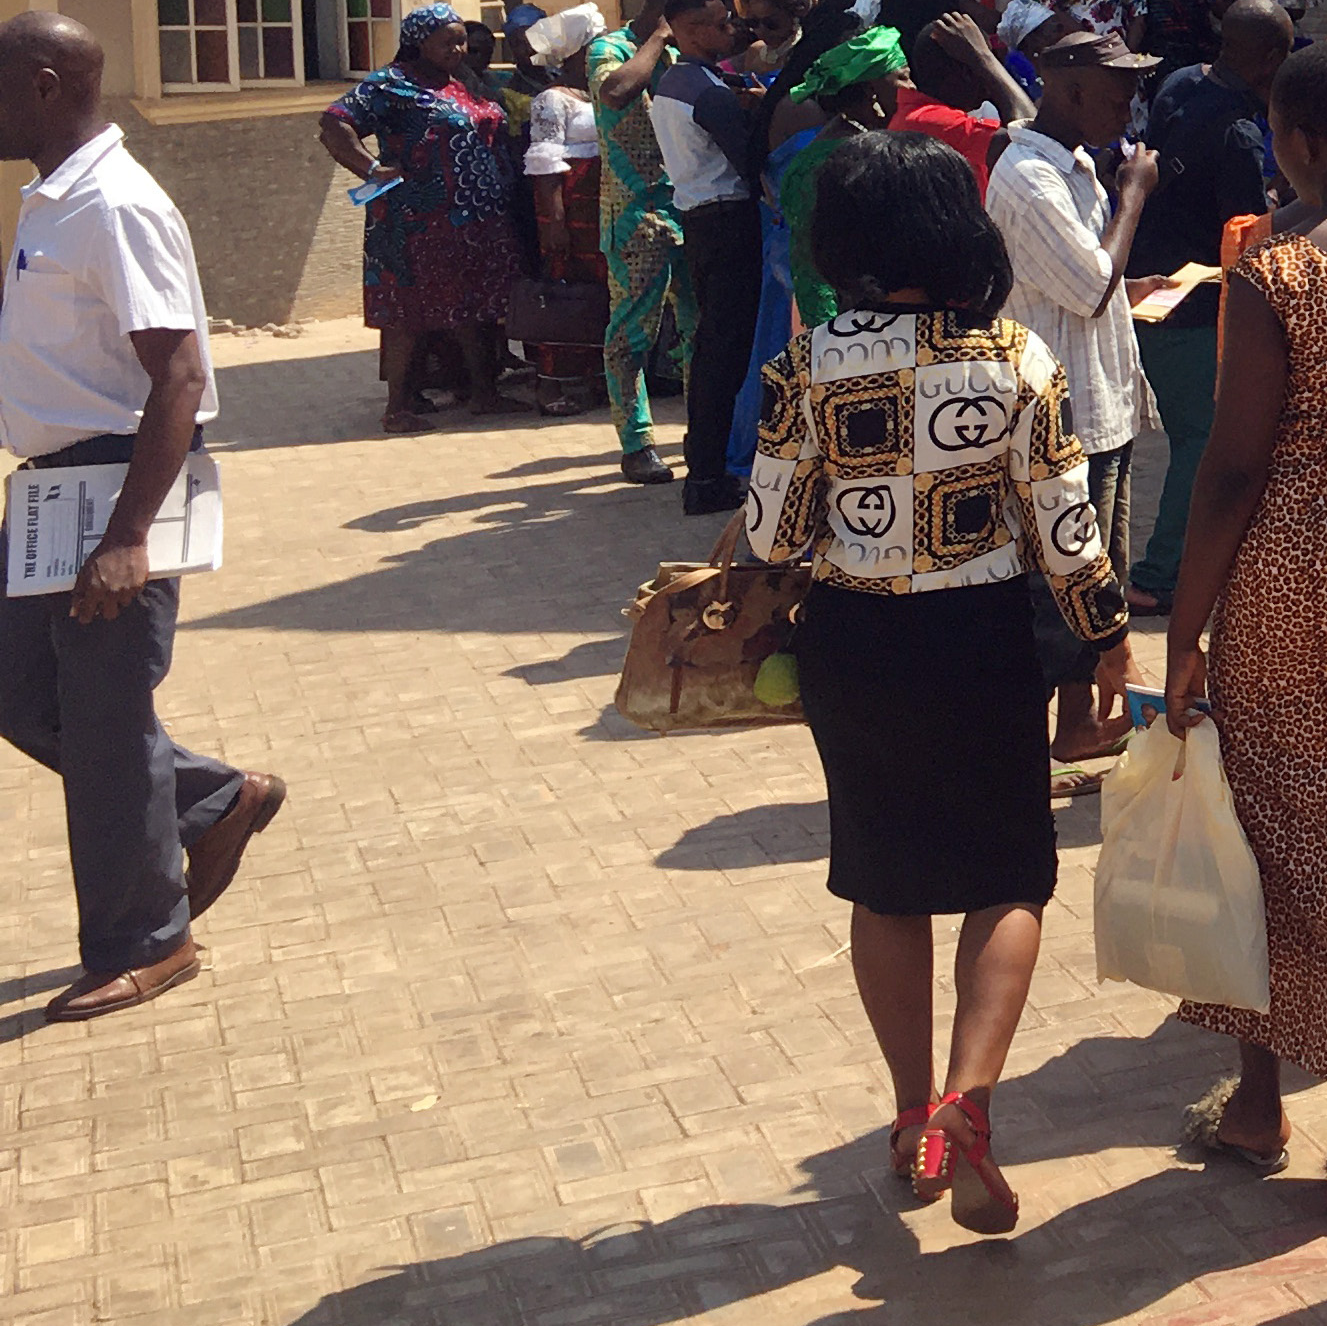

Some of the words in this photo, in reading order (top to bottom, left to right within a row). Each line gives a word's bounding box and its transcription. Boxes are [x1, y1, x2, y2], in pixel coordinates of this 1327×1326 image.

[27, 483, 40, 503] FILE
[27, 505, 39, 527] FLAT
[25, 529, 39, 561] OFFICE
[23, 562, 36, 579] THE
